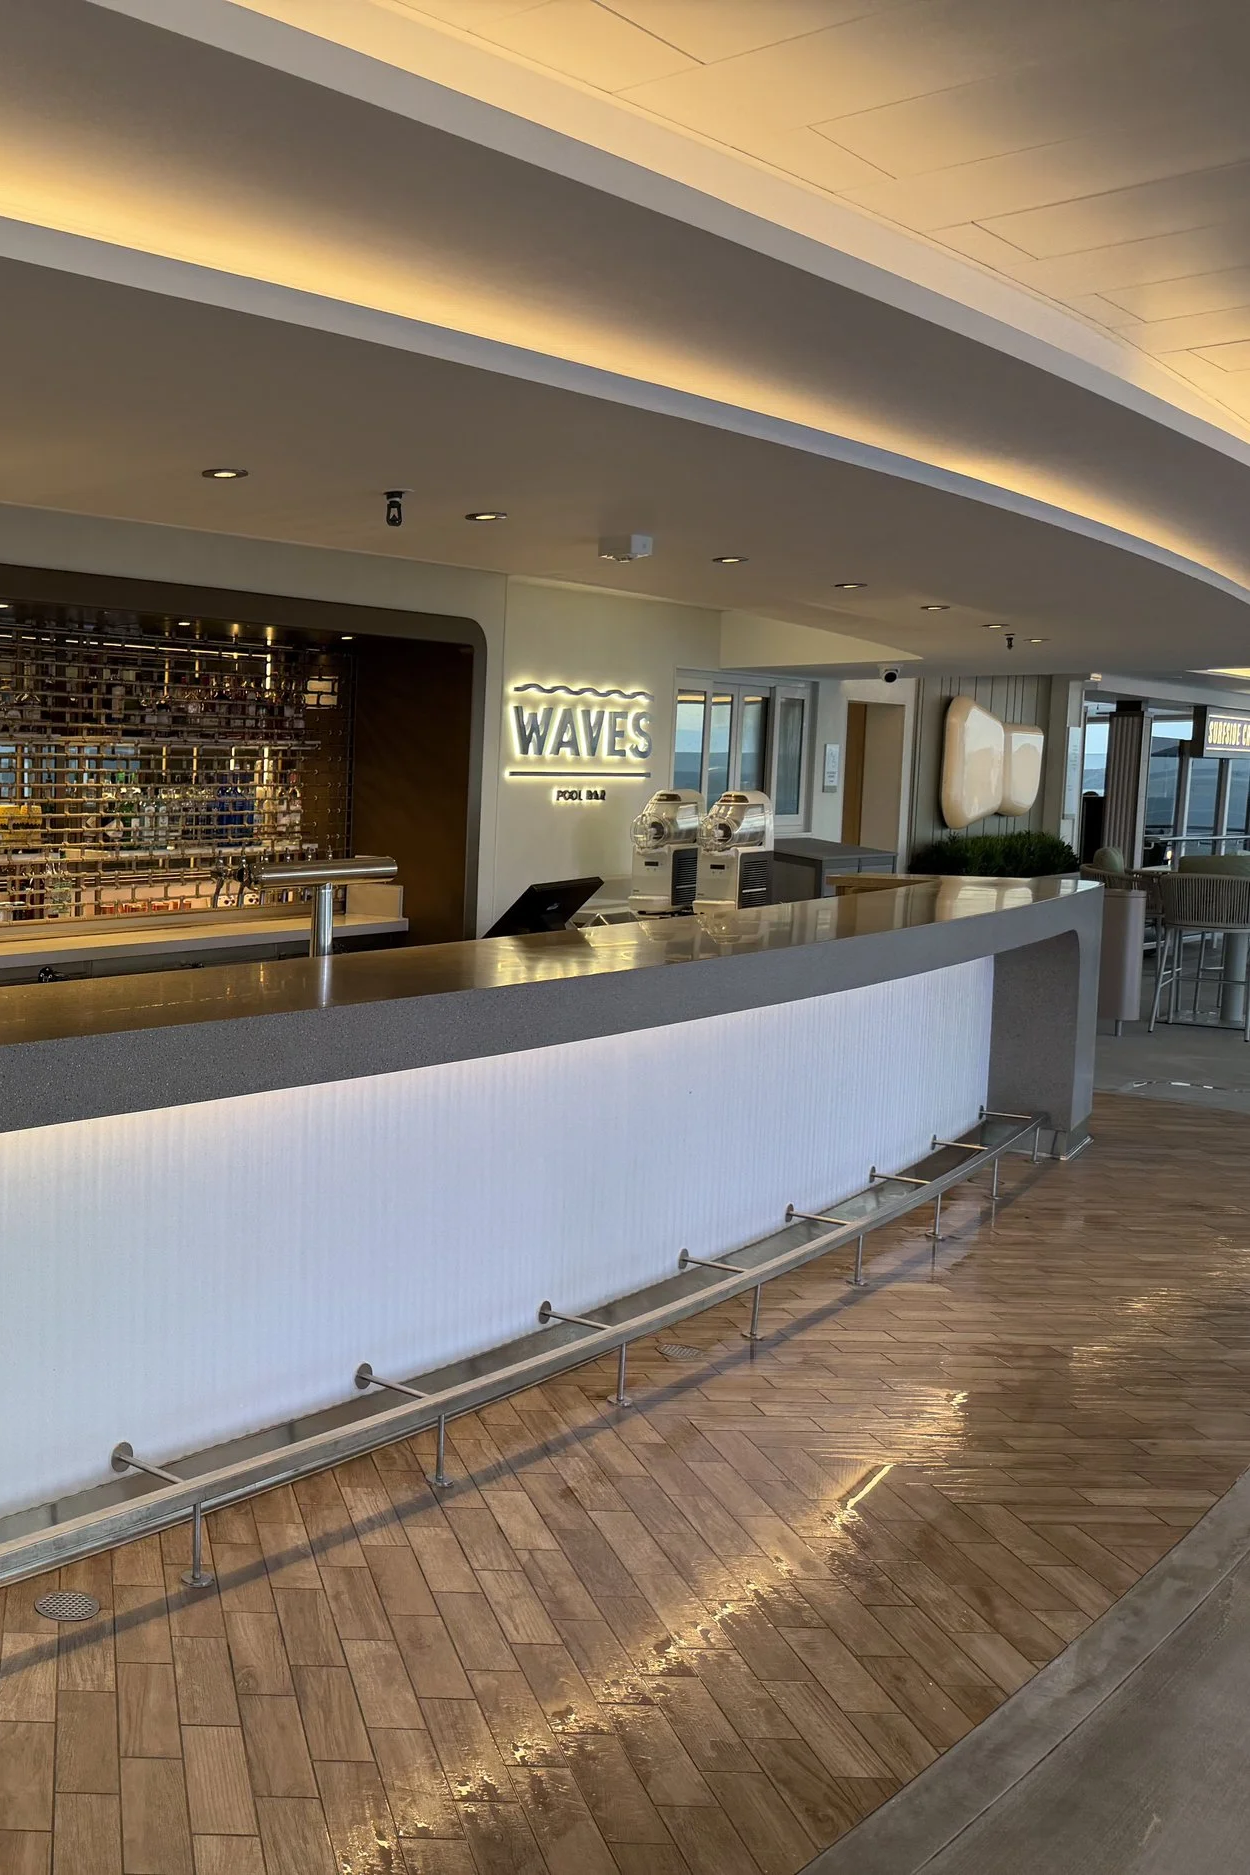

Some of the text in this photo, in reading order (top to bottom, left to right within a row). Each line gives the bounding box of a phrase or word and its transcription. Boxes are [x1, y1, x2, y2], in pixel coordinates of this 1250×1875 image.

[513, 706, 653, 759] WAVES
[1208, 720, 1241, 746] SURFSIDE
[556, 789, 606, 801] POOL BAR
